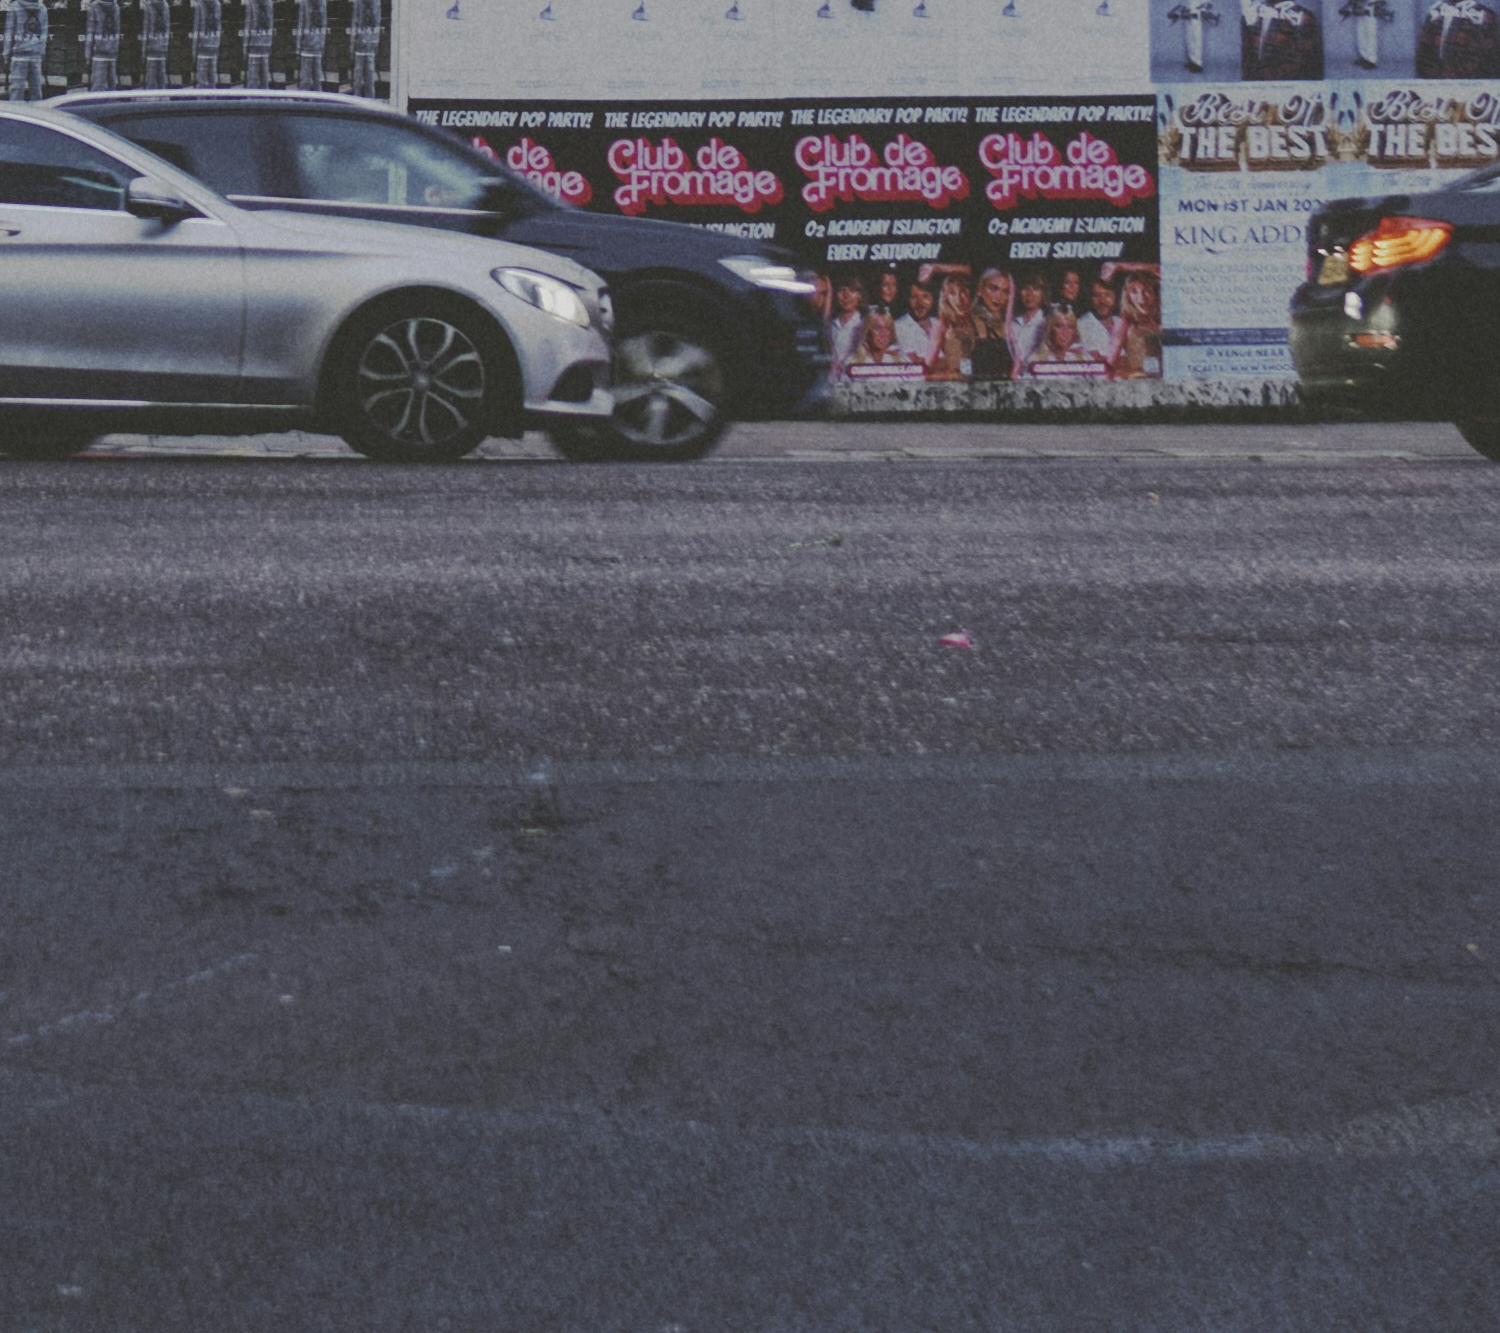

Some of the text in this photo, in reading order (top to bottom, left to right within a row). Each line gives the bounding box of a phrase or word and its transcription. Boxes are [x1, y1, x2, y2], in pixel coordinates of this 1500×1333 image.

[416, 110, 594, 129] THE LEGENDARY POP PARTY!
[605, 110, 784, 128] THE LEGENDARY POP PARTY!
[791, 107, 968, 125] THE LEGENDARY POP PARTY!
[975, 105, 1154, 123] THE LEGENDARY POP PARTY!
[1180, 126, 1329, 158] THE BEST
[1368, 123, 1425, 156] THE
[507, 137, 550, 170] de
[607, 137, 742, 174] Club de
[795, 134, 929, 171] Club de
[979, 132, 1111, 169] Club de
[614, 170, 779, 208] Fromage
[802, 166, 965, 204] Fromage
[986, 164, 1149, 203] Fromage
[1179, 199, 1218, 212] MON
[1254, 199, 1288, 212] JAN
[805, 218, 961, 237] O2 ACADEMY ISLINGTON
[988, 216, 1145, 235] O2 ACADEMY ISLINGTON
[1174, 225, 1238, 245] KING
[827, 243, 941, 261] EVERY SATURDAY
[1010, 241, 1123, 258] EVERY SATURDAY
